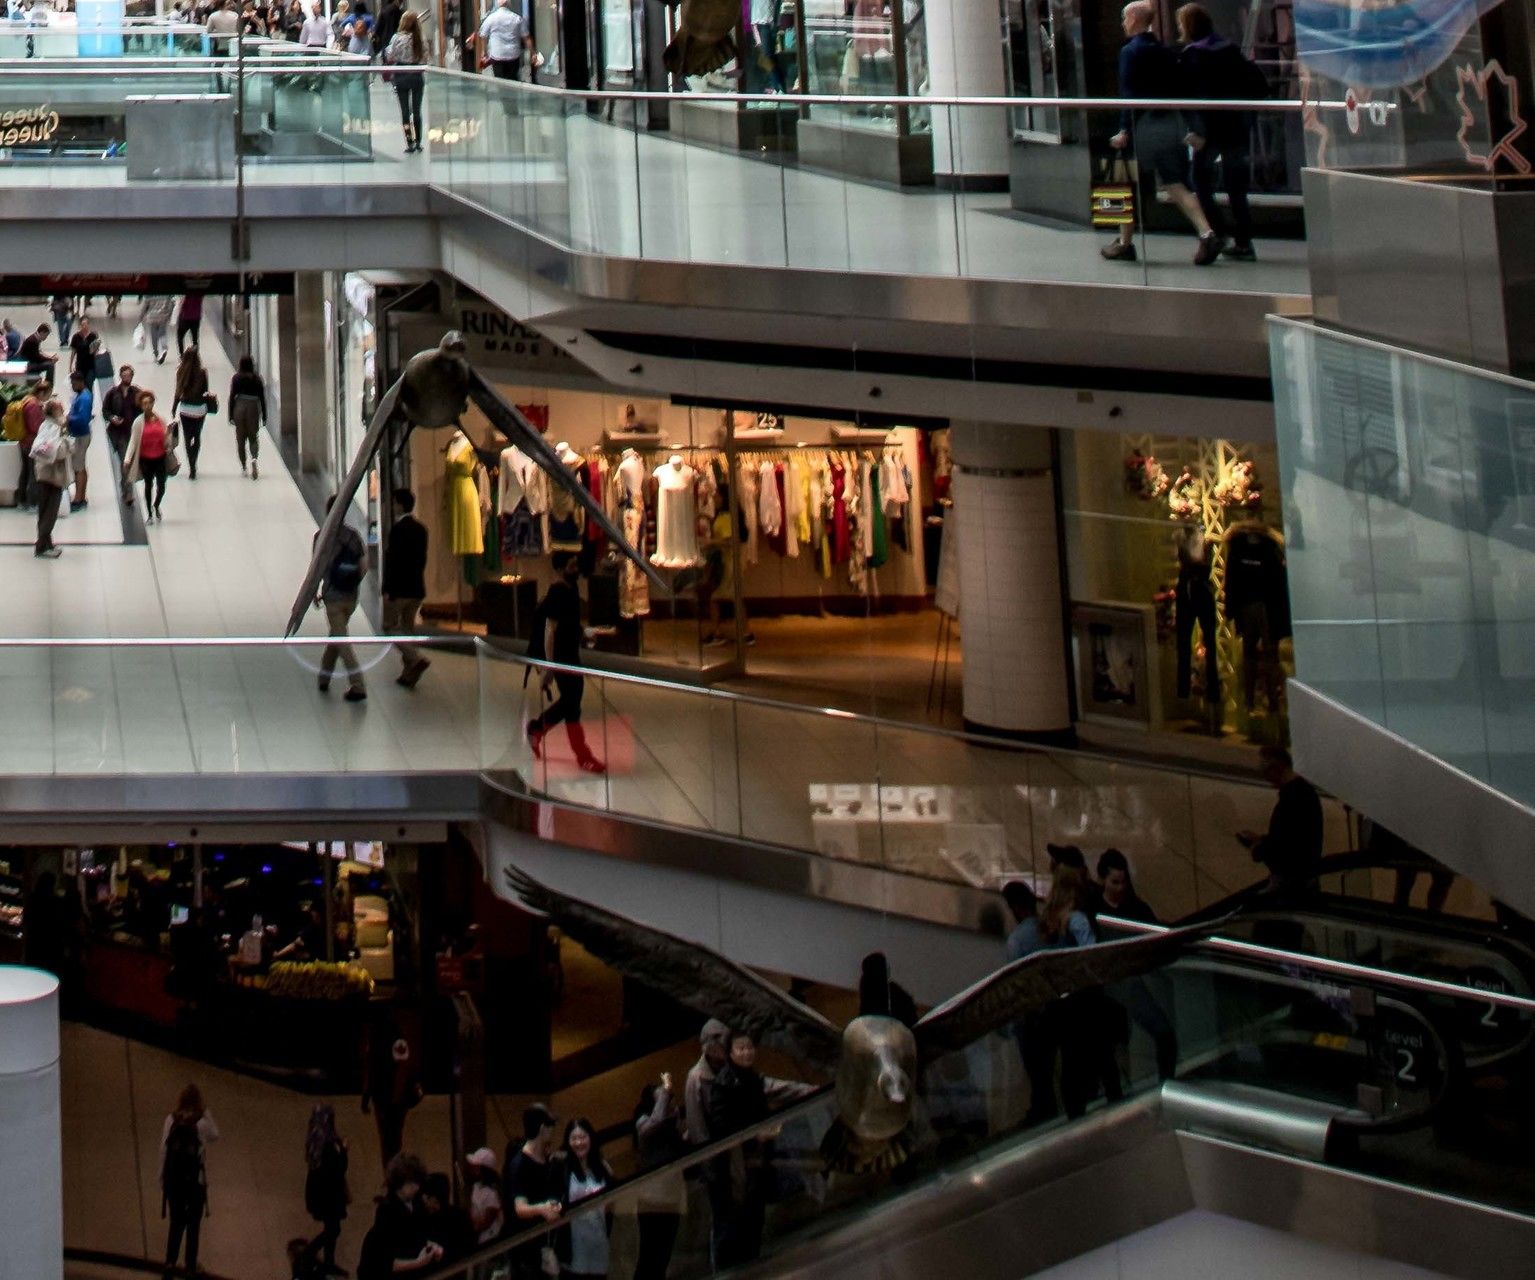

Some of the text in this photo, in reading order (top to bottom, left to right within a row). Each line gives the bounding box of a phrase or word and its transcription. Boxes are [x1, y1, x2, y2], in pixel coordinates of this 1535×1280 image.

[484, 340, 539, 355] MADE
[1384, 1026, 1424, 1049] Level
[1396, 1048, 1417, 1082] 2
